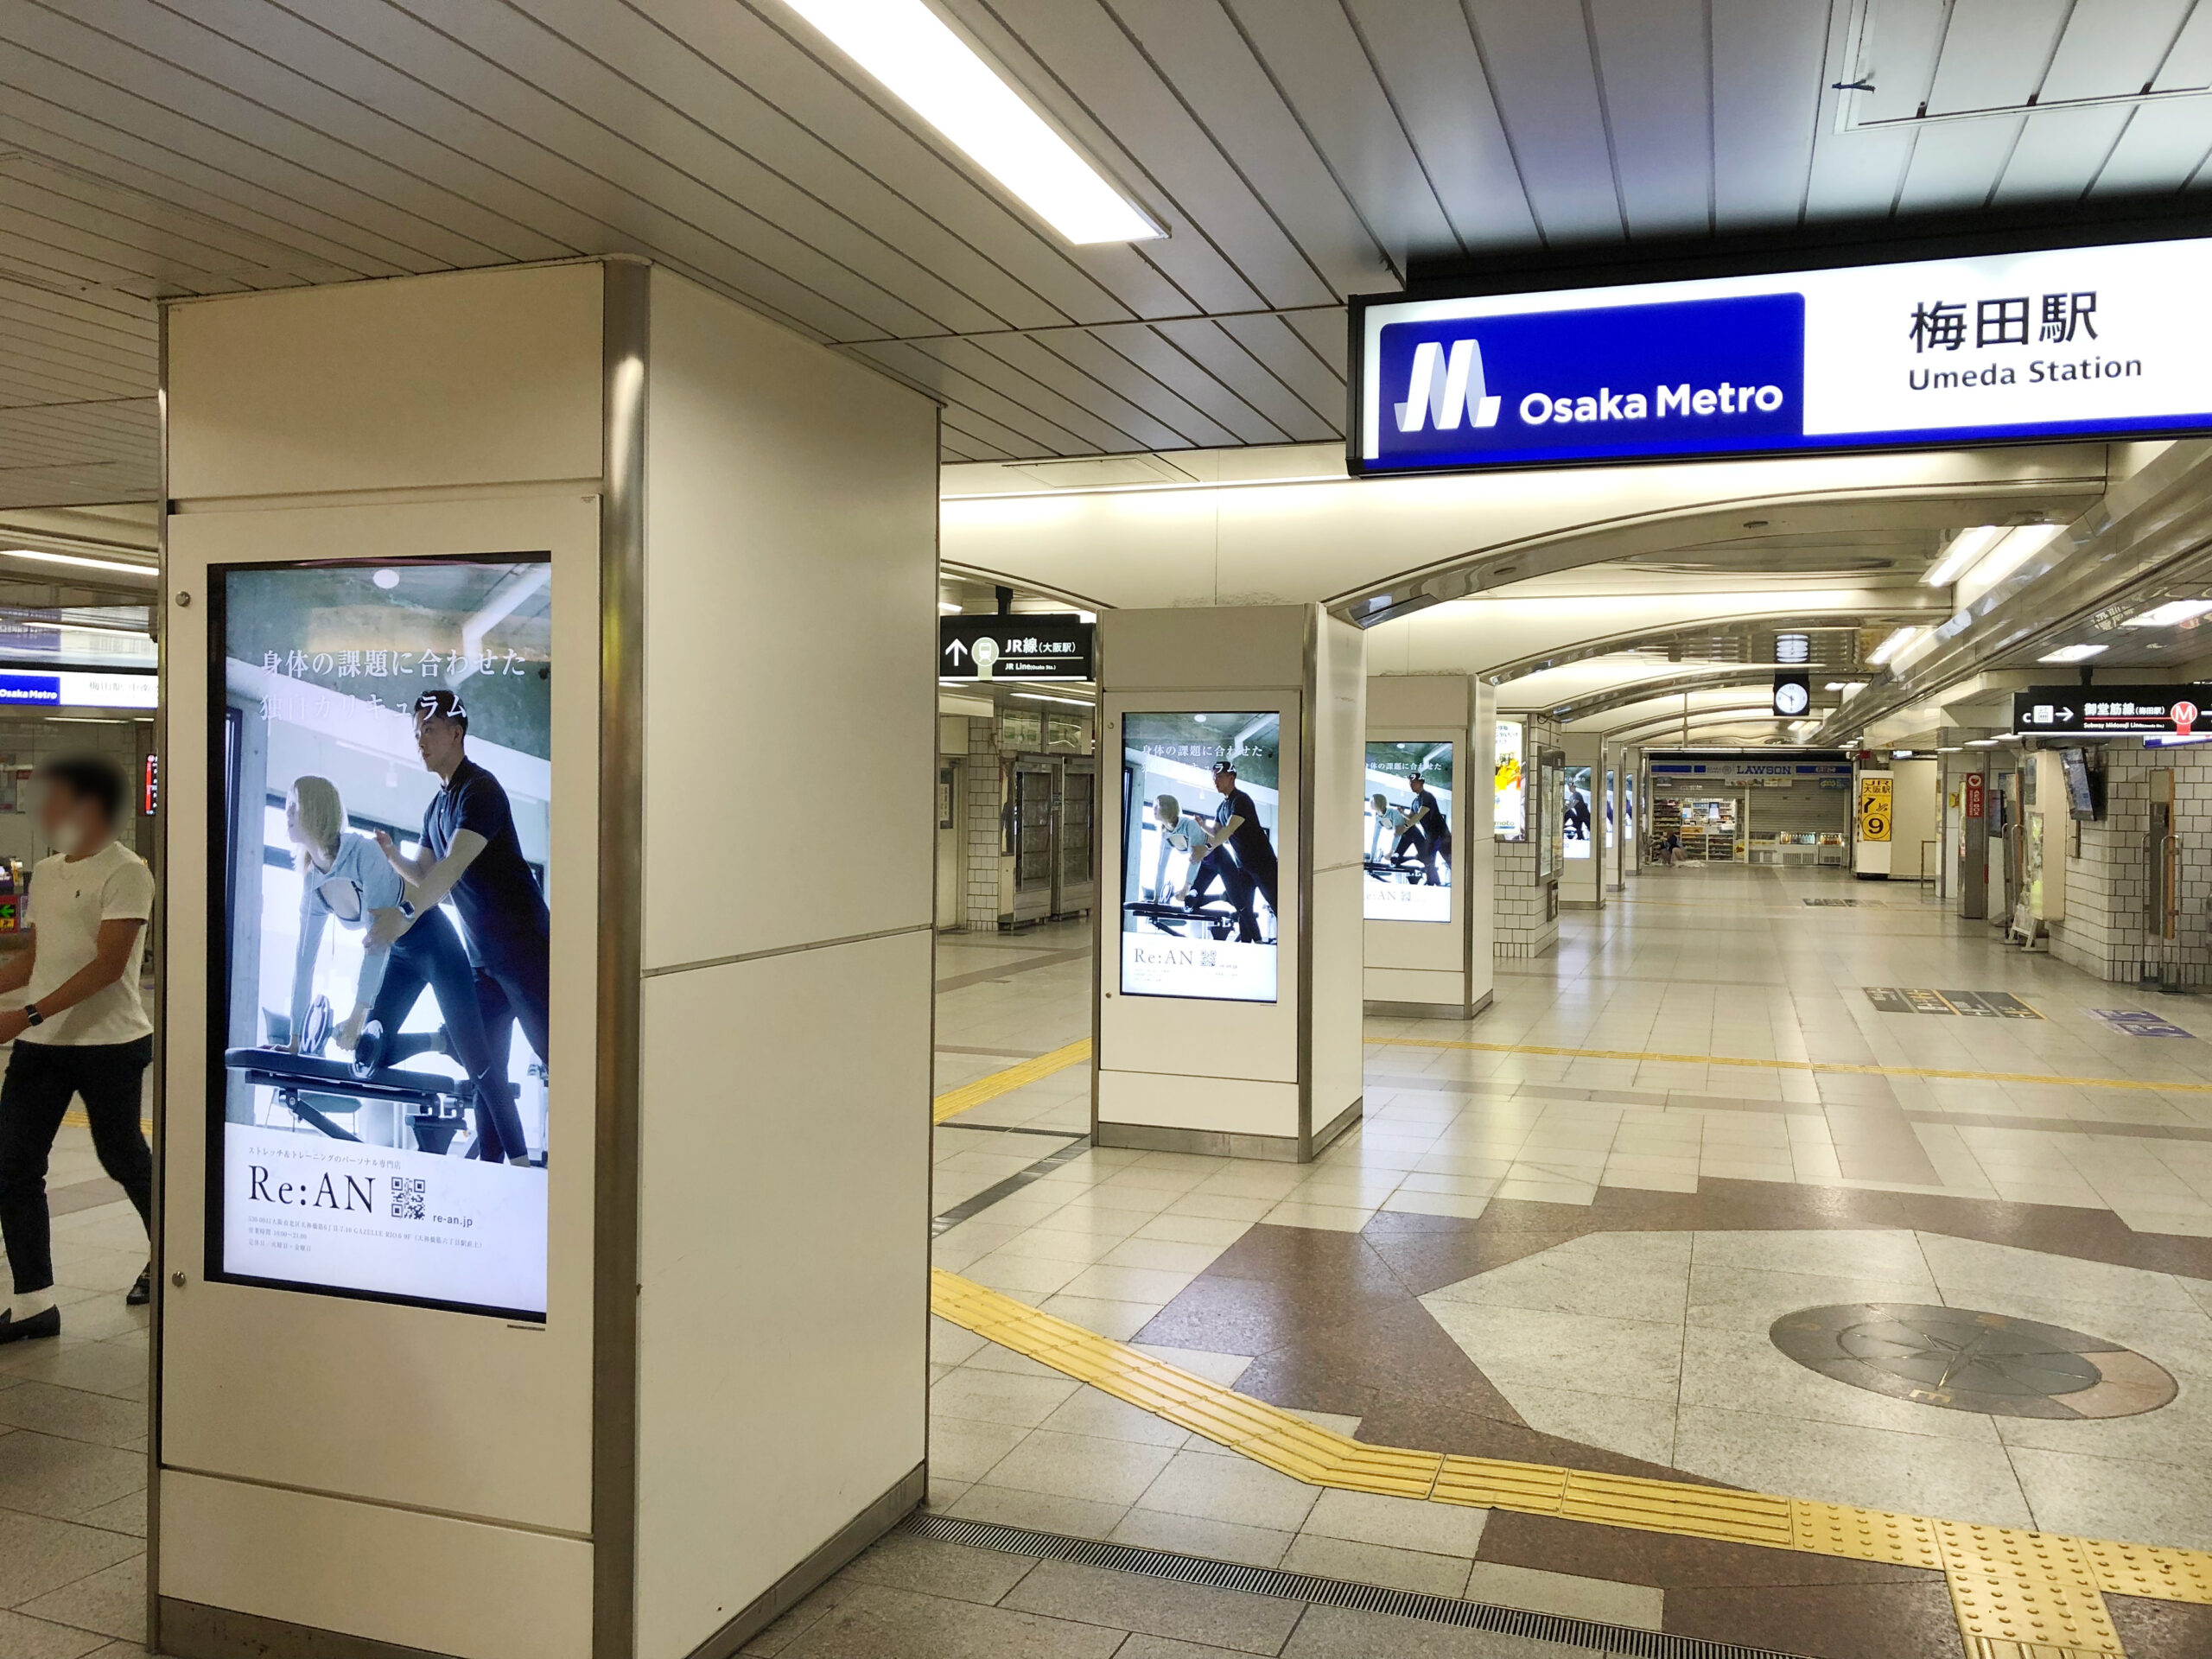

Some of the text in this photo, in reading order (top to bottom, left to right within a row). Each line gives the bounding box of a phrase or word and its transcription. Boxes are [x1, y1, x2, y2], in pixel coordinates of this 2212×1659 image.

[1908, 290, 2099, 354] 梅田駅
[1909, 355, 2142, 391] Umeda Station
[1518, 382, 1784, 425] Osaka Metro
[262, 648, 526, 678] 身体の課題に合わせた
[29, 690, 58, 700] Metro
[1736, 766, 1792, 775] LAWSON
[1863, 785, 1891, 794] 大阪駅
[1868, 817, 1884, 835] 9
[1134, 948, 1193, 965] Re:AN
[247, 1164, 377, 1214] Re:AN
[432, 1213, 474, 1228] re-an.jp
